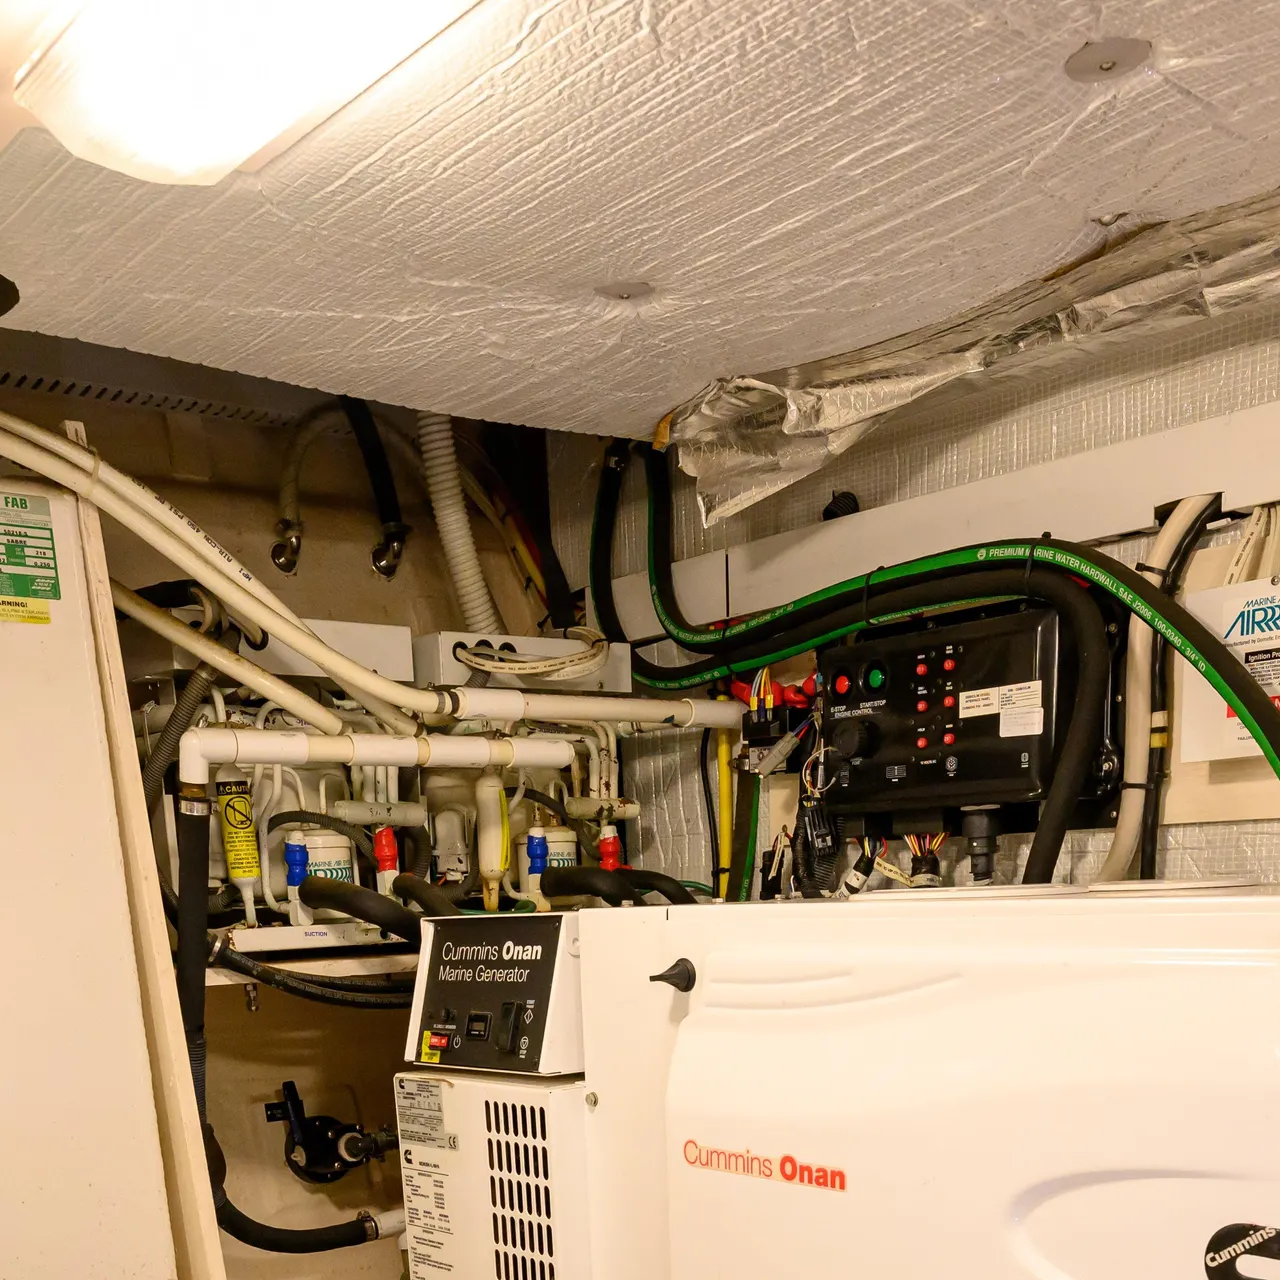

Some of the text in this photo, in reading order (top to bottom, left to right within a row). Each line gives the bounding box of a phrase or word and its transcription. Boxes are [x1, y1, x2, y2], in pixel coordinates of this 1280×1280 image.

[4, 496, 28, 509] FAB
[169, 505, 184, 520] PSI
[187, 520, 201, 533] 450
[204, 534, 233, 562] AIR-CON
[1243, 595, 1276, 609] MARINE
[989, 547, 1024, 558] PREMIUM
[1055, 552, 1080, 569] WATER
[1080, 562, 1118, 593] HARDWALL
[1119, 587, 1133, 604] SAE
[1132, 599, 1152, 620] J2006
[1154, 618, 1182, 647] 100-0340
[1197, 660, 1206, 673] ID
[1249, 653, 1271, 662] Ignition
[835, 708, 873, 718] ENGINE CONTROL
[308, 860, 333, 868] MARINE
[442, 941, 542, 961] Cummins Onan
[439, 965, 530, 982] Marine Generator
[683, 1139, 846, 1191] Cummins Onan
[1205, 1227, 1276, 1267] Cummins
